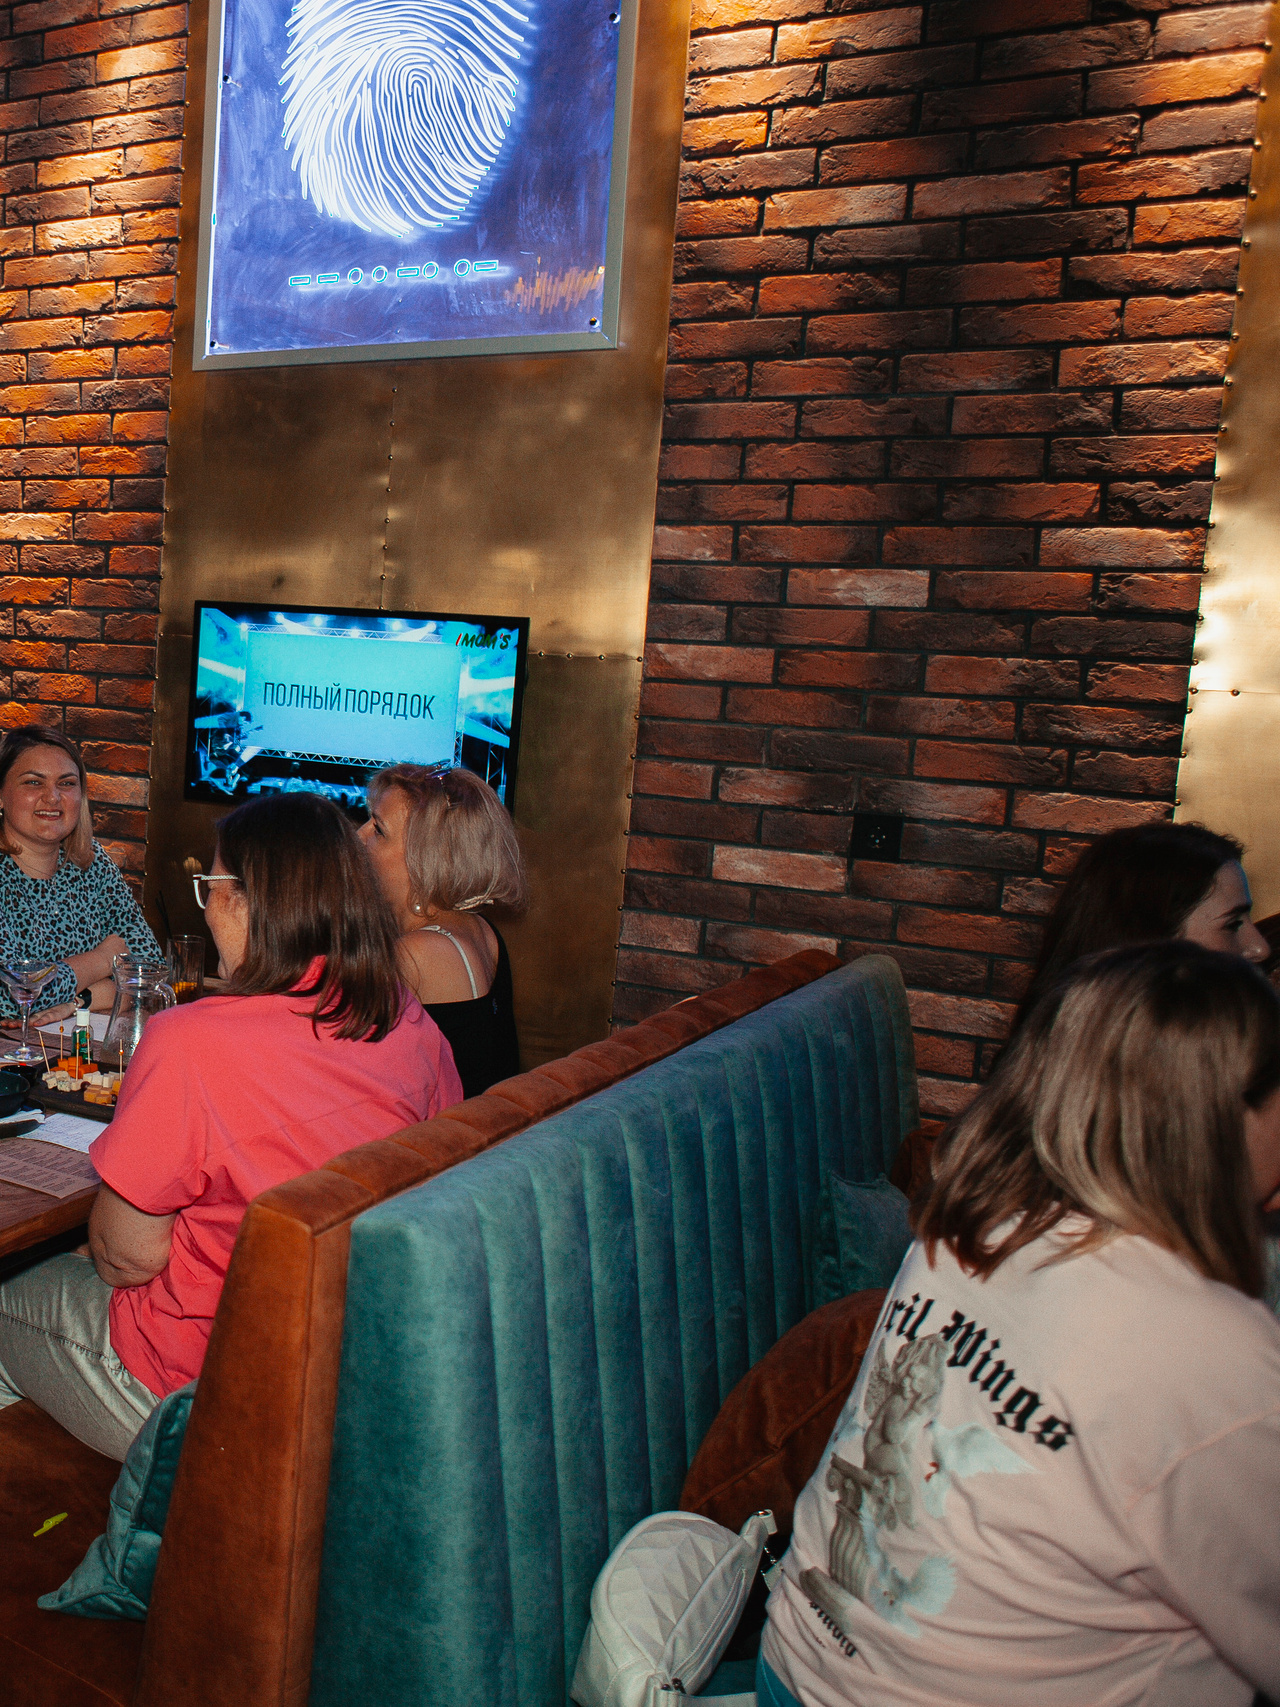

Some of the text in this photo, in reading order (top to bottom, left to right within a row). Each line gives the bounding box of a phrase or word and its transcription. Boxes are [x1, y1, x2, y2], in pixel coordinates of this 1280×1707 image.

[455, 633, 511, 650] IMOM'S
[263, 681, 435, 720] ПОЛНЫЙ ПОРЯДОК
